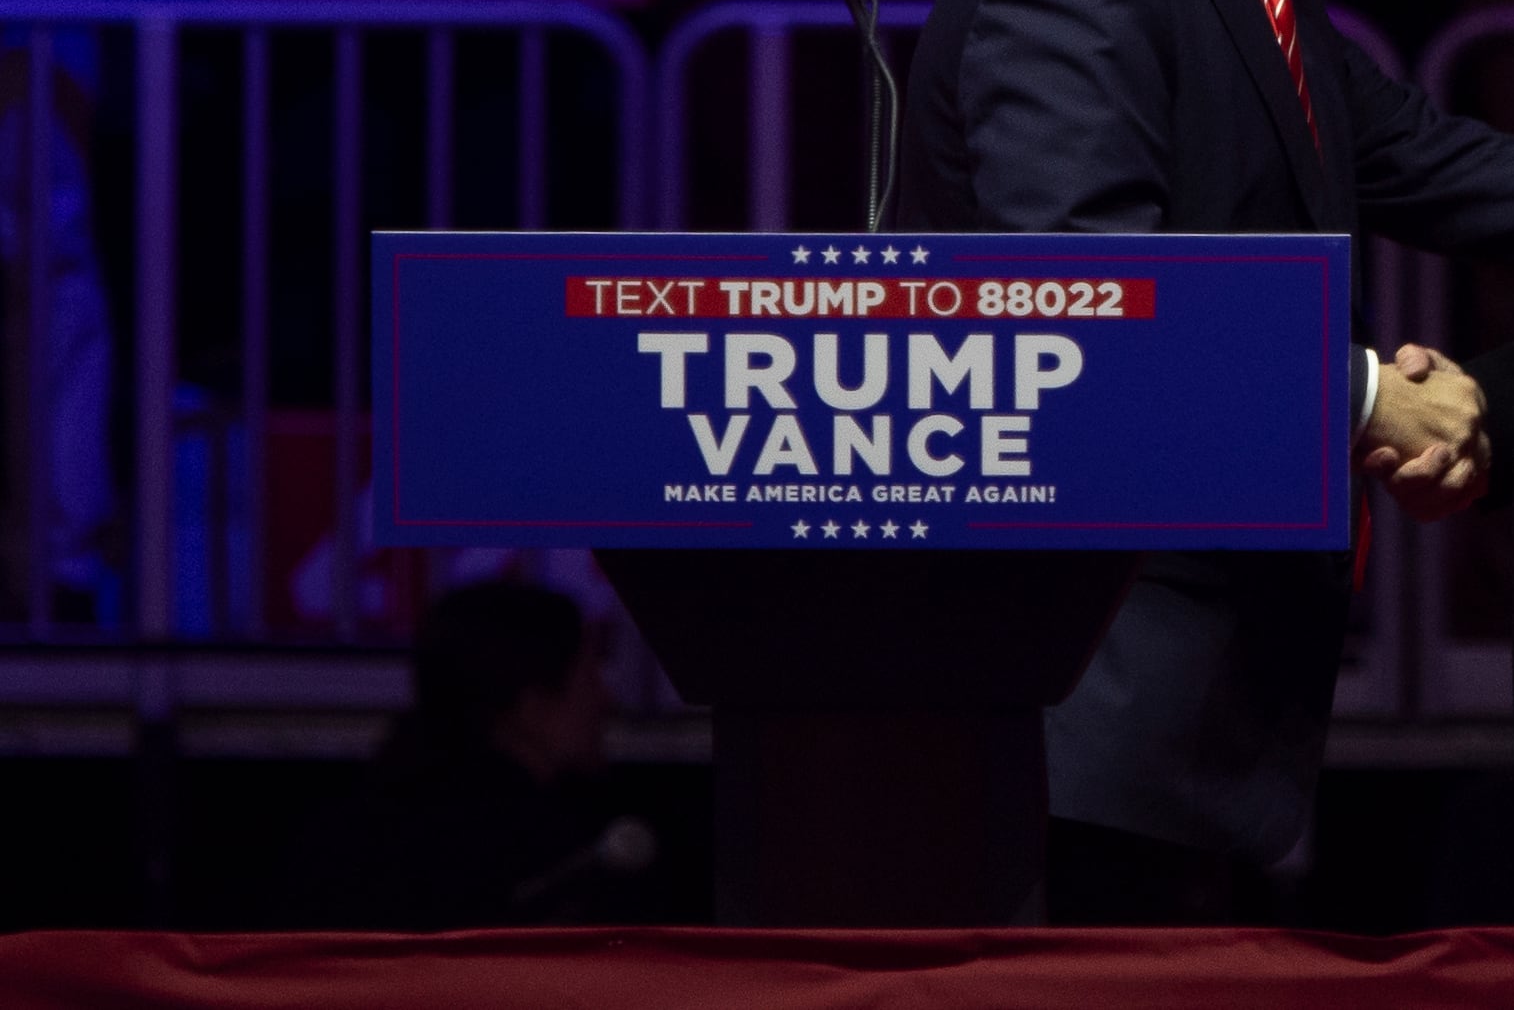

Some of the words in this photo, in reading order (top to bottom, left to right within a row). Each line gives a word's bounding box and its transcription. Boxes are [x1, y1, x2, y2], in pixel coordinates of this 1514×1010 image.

[586, 280, 704, 315] TEXT
[719, 280, 887, 316] TRUMP
[899, 280, 963, 316] TO
[977, 281, 1124, 317] 88022
[637, 332, 1084, 411] TRUMP
[687, 414, 1031, 477] VANCE
[664, 484, 737, 503] MAKE
[745, 484, 863, 503] AMERICA
[871, 484, 956, 504] GREAT
[964, 485, 1057, 504] AGAIN!
